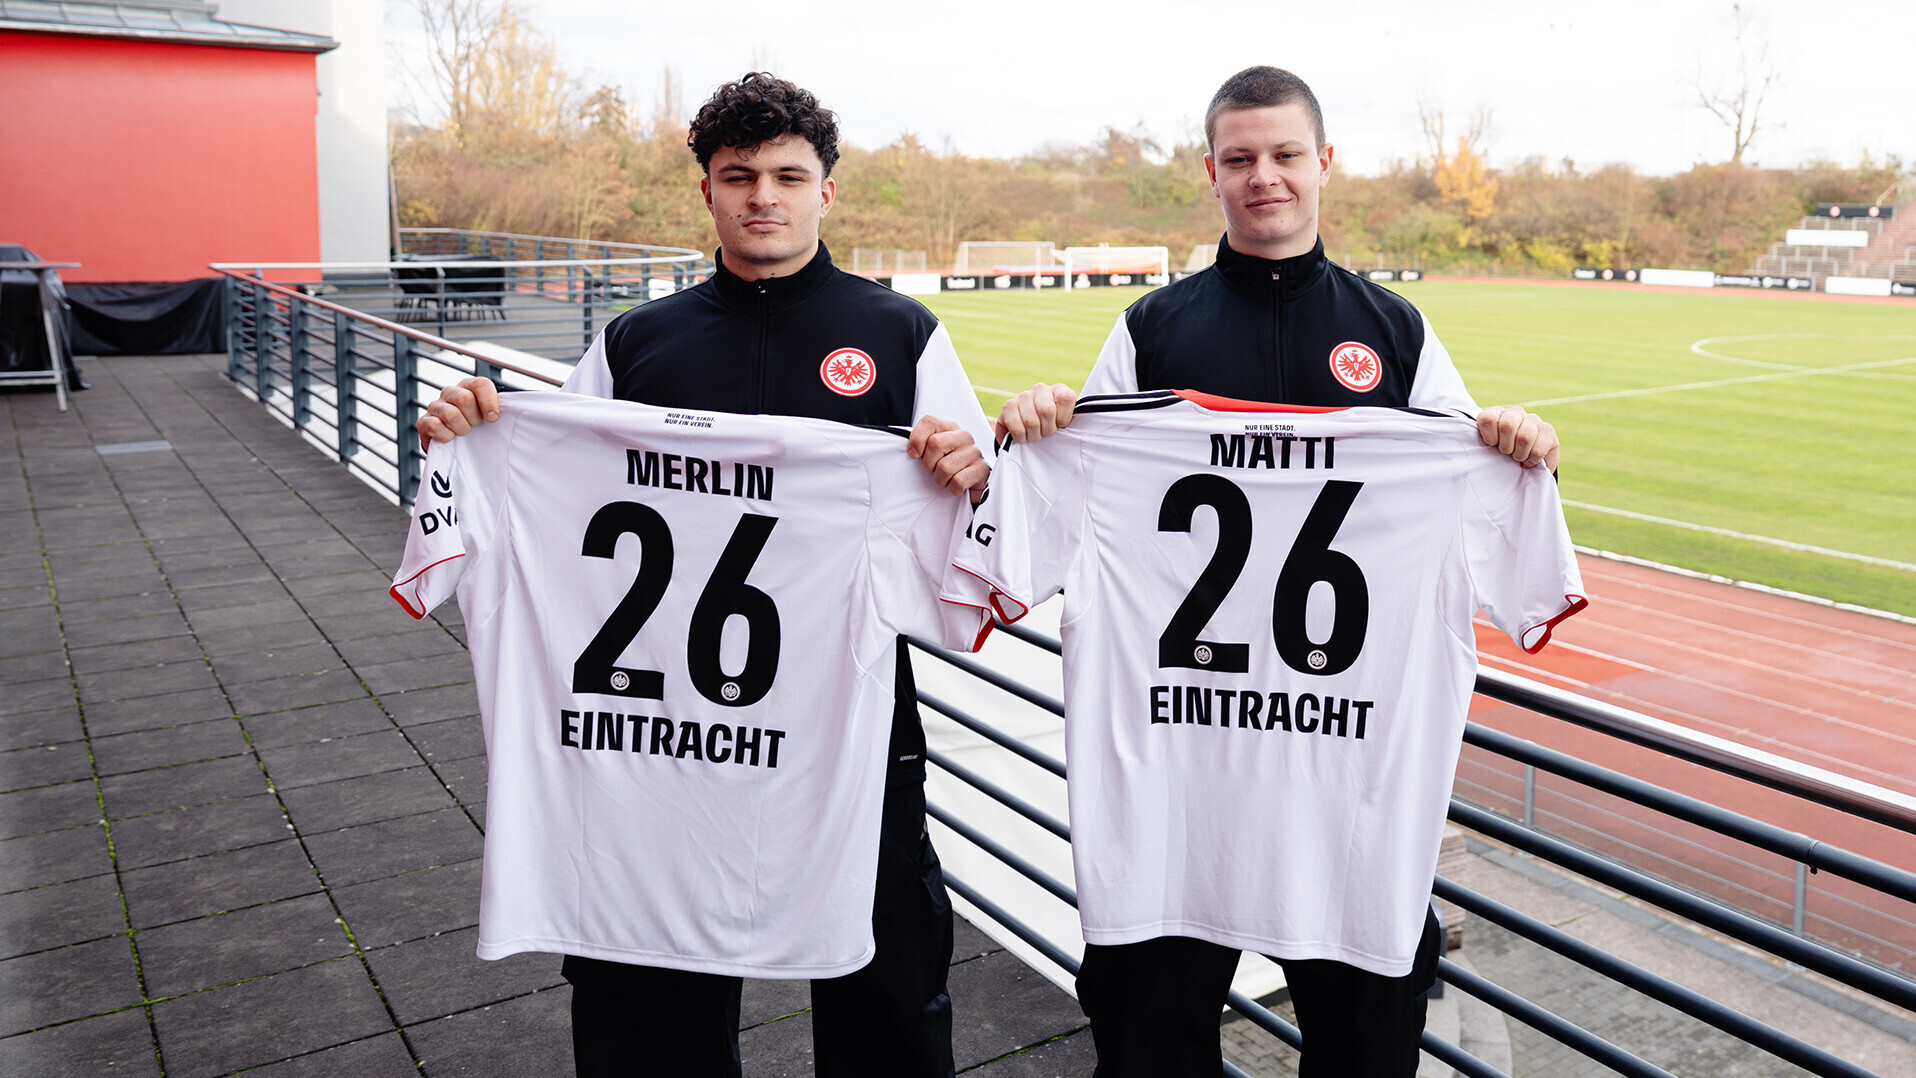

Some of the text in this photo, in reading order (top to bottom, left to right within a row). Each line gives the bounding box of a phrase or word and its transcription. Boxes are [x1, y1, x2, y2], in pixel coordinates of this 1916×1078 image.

[1210, 433, 1336, 469] MATTI
[1274, 424, 1296, 432] STADT.
[626, 448, 774, 502] MERLIN
[1157, 474, 1369, 676] 26
[571, 501, 781, 707] 26
[560, 709, 786, 769] EINTRACHT
[1150, 685, 1374, 740] EINTRACHT
